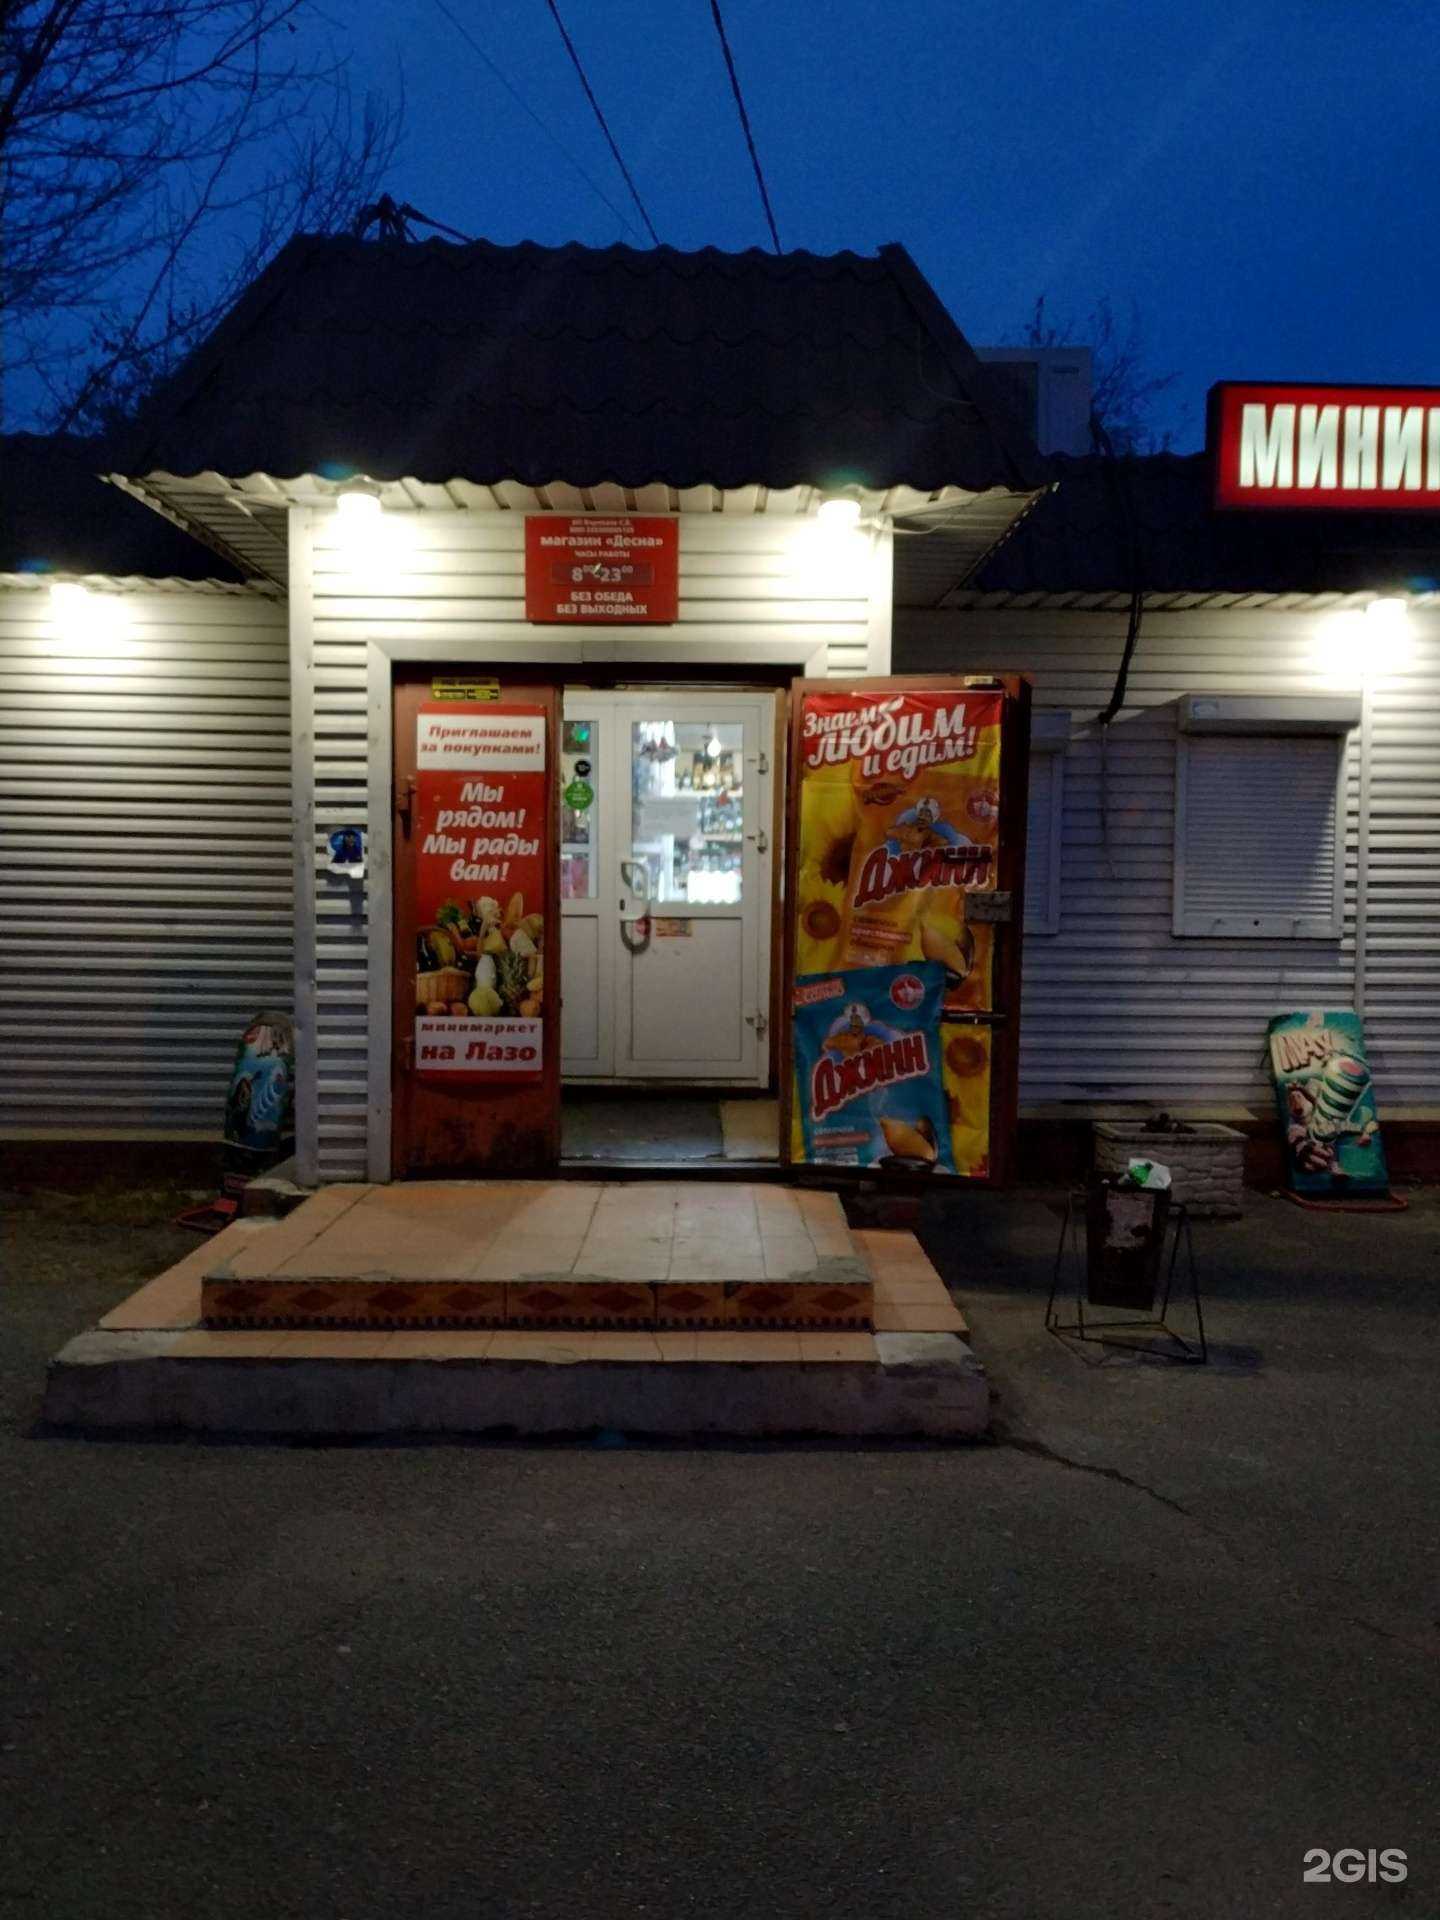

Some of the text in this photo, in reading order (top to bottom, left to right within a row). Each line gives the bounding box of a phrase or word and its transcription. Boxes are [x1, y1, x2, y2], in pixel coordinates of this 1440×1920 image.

[1239, 403, 1440, 491] МИНИ
[540, 536, 601, 546] магазин
[571, 591, 634, 602] БЕЗ ОБЕДА
[556, 604, 648, 615] БЕЗ ВЫХОДНЫХ
[428, 725, 532, 739] Приглашаем
[420, 742, 541, 756] за покупками!
[863, 725, 977, 779] и едим!
[460, 782, 504, 802] Мы
[436, 805, 526, 832] рядом!
[422, 833, 539, 860] Мы рады
[450, 859, 509, 882] вам!
[421, 1023, 537, 1036] минимаркет
[421, 1042, 537, 1061] на Лазо
